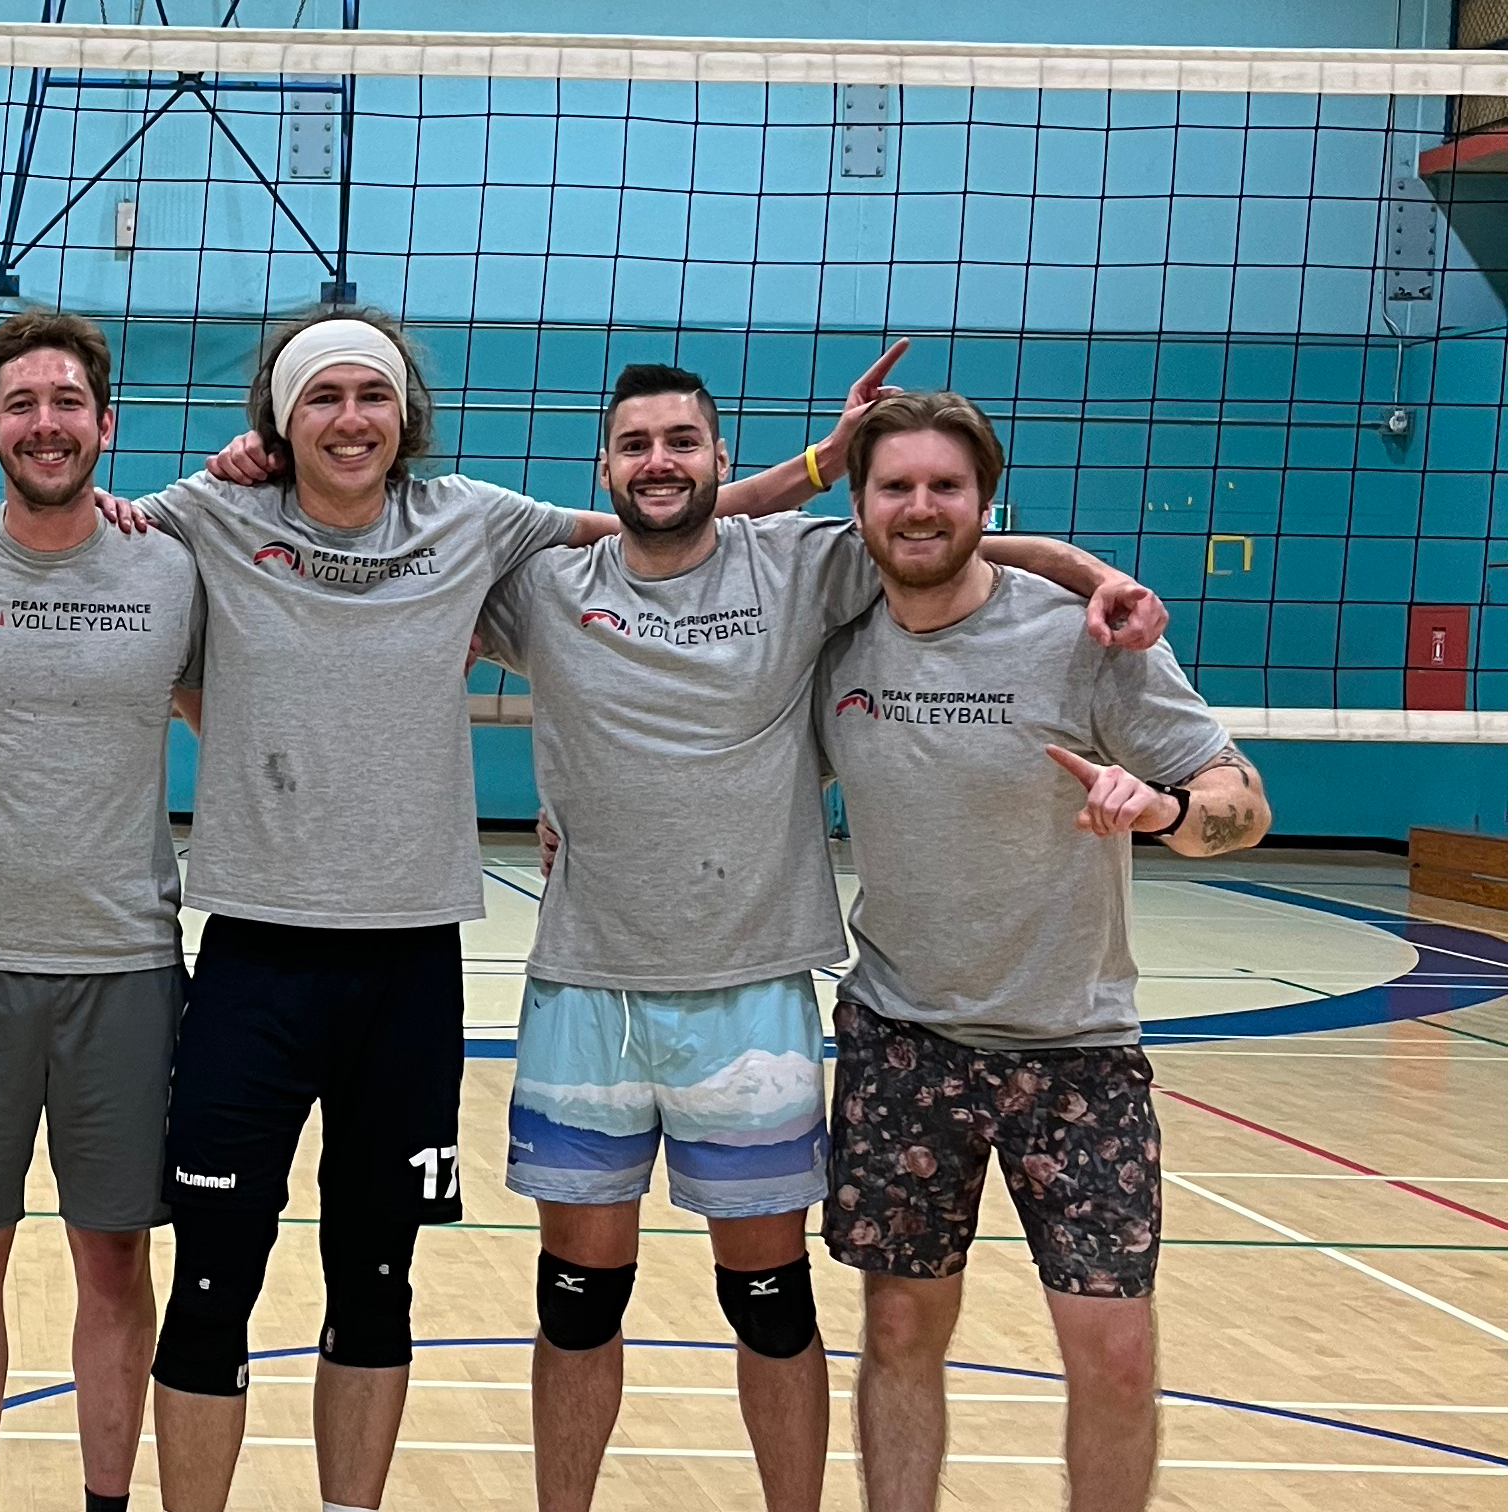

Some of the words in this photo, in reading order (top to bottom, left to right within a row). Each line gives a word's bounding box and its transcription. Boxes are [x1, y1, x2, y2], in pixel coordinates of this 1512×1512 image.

[313, 550, 348, 566] PEAK
[12, 600, 48, 612] PEAK
[53, 602, 151, 614] PERFORMANCE
[12, 613, 151, 632] VOLLEYBALL
[638, 612, 670, 629] PEAK
[638, 620, 768, 645] VOLLEYBALL
[882, 689, 912, 702] PEAK
[916, 692, 1015, 704] PERFORMANCE
[882, 704, 1013, 724] VOLLEYBALL
[176, 1166, 236, 1189] hummel
[409, 1145, 458, 1199] 17
